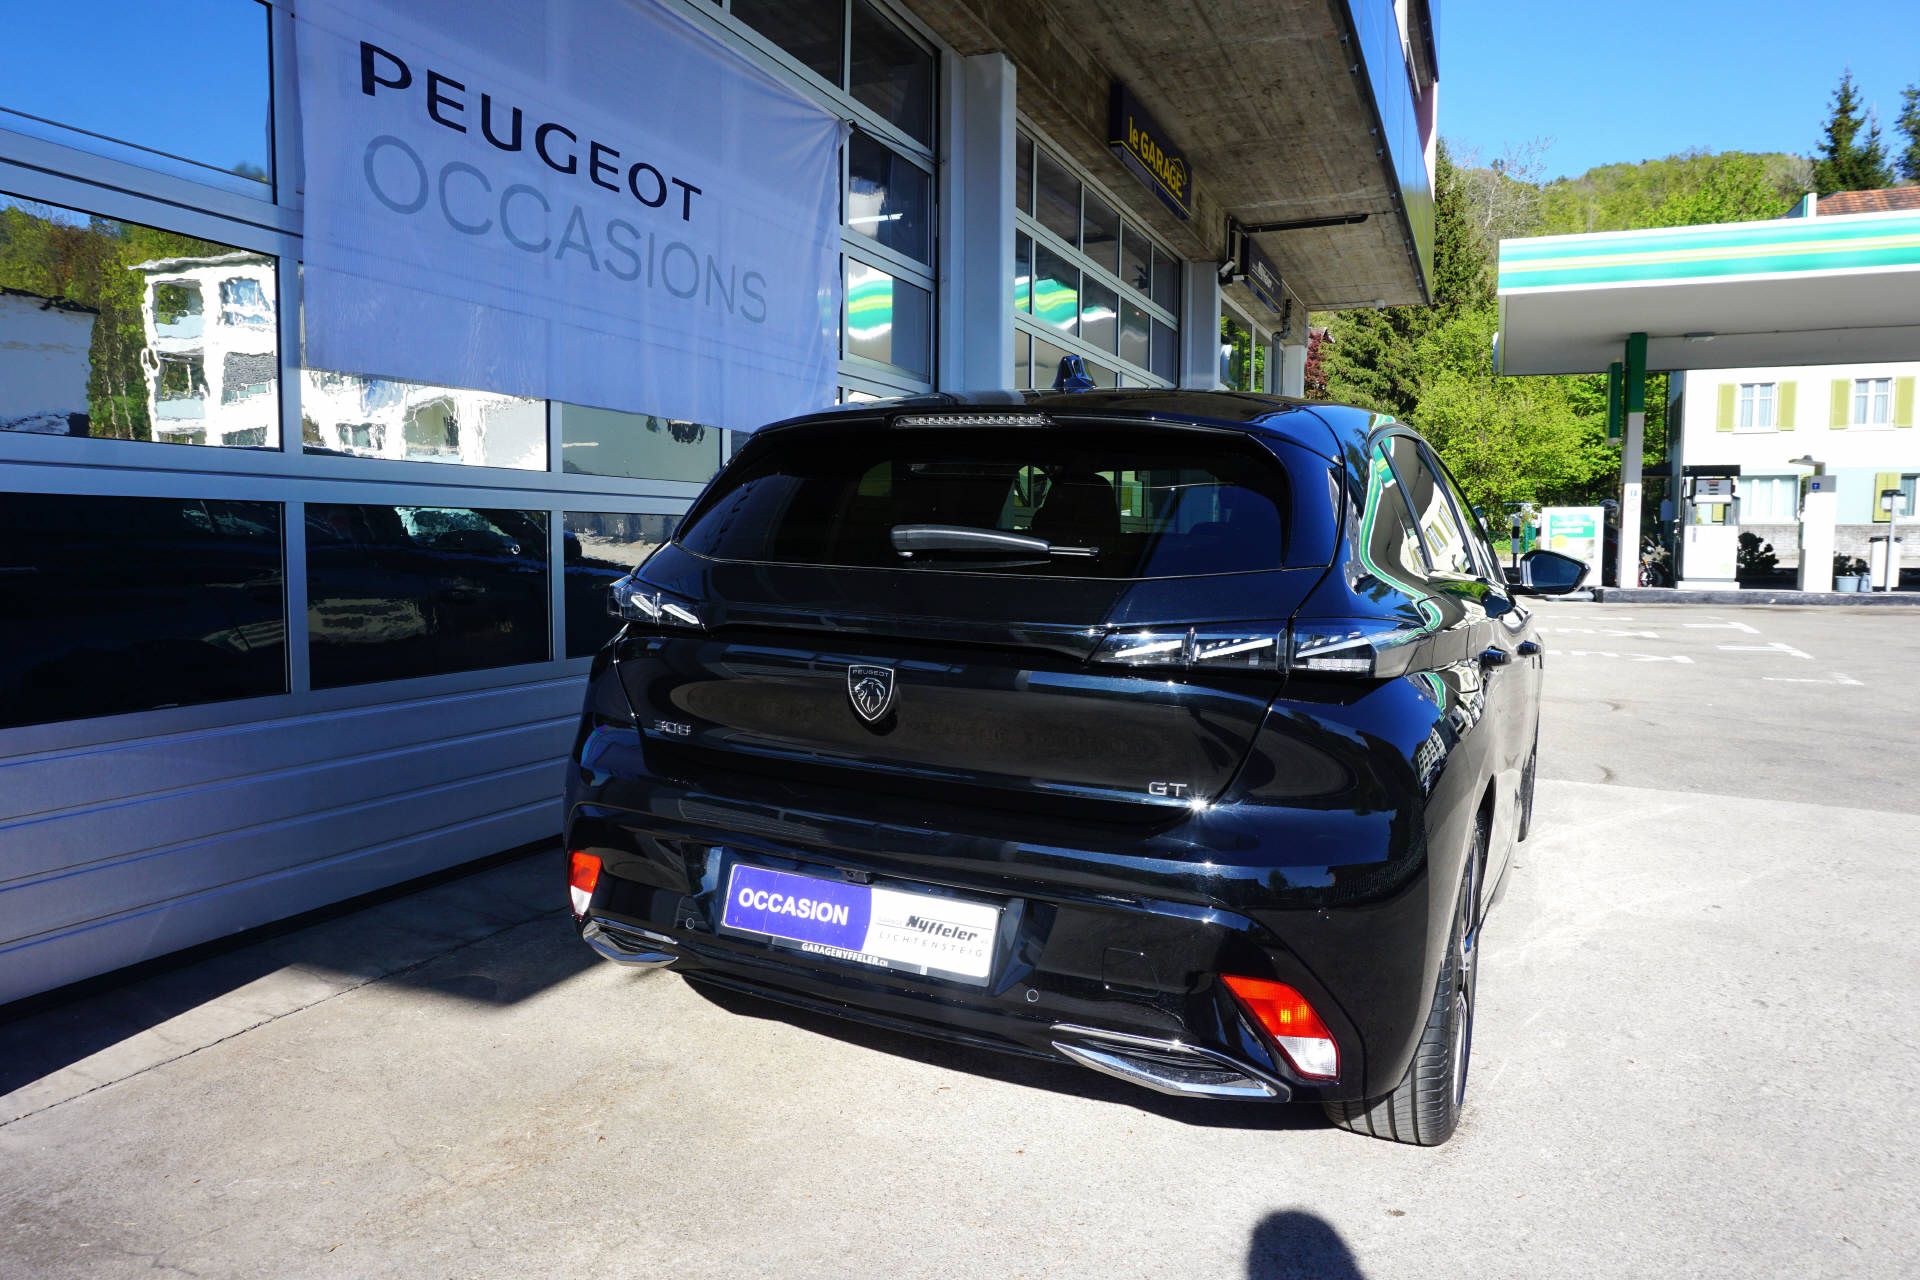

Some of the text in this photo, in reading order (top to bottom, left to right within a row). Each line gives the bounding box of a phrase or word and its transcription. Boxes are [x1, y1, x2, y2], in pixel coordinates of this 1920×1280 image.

[360, 40, 702, 221] PEUGEOT
[1128, 116, 1183, 198] le GARAGE
[363, 135, 768, 324] OCCASIONS
[852, 669, 889, 678] PEUGEOT
[654, 719, 692, 736] 308
[1148, 781, 1188, 797] GT
[738, 887, 849, 926] OCCASION
[905, 914, 978, 942] Nyffeler
[879, 931, 984, 958] LICHTENSTEIG
